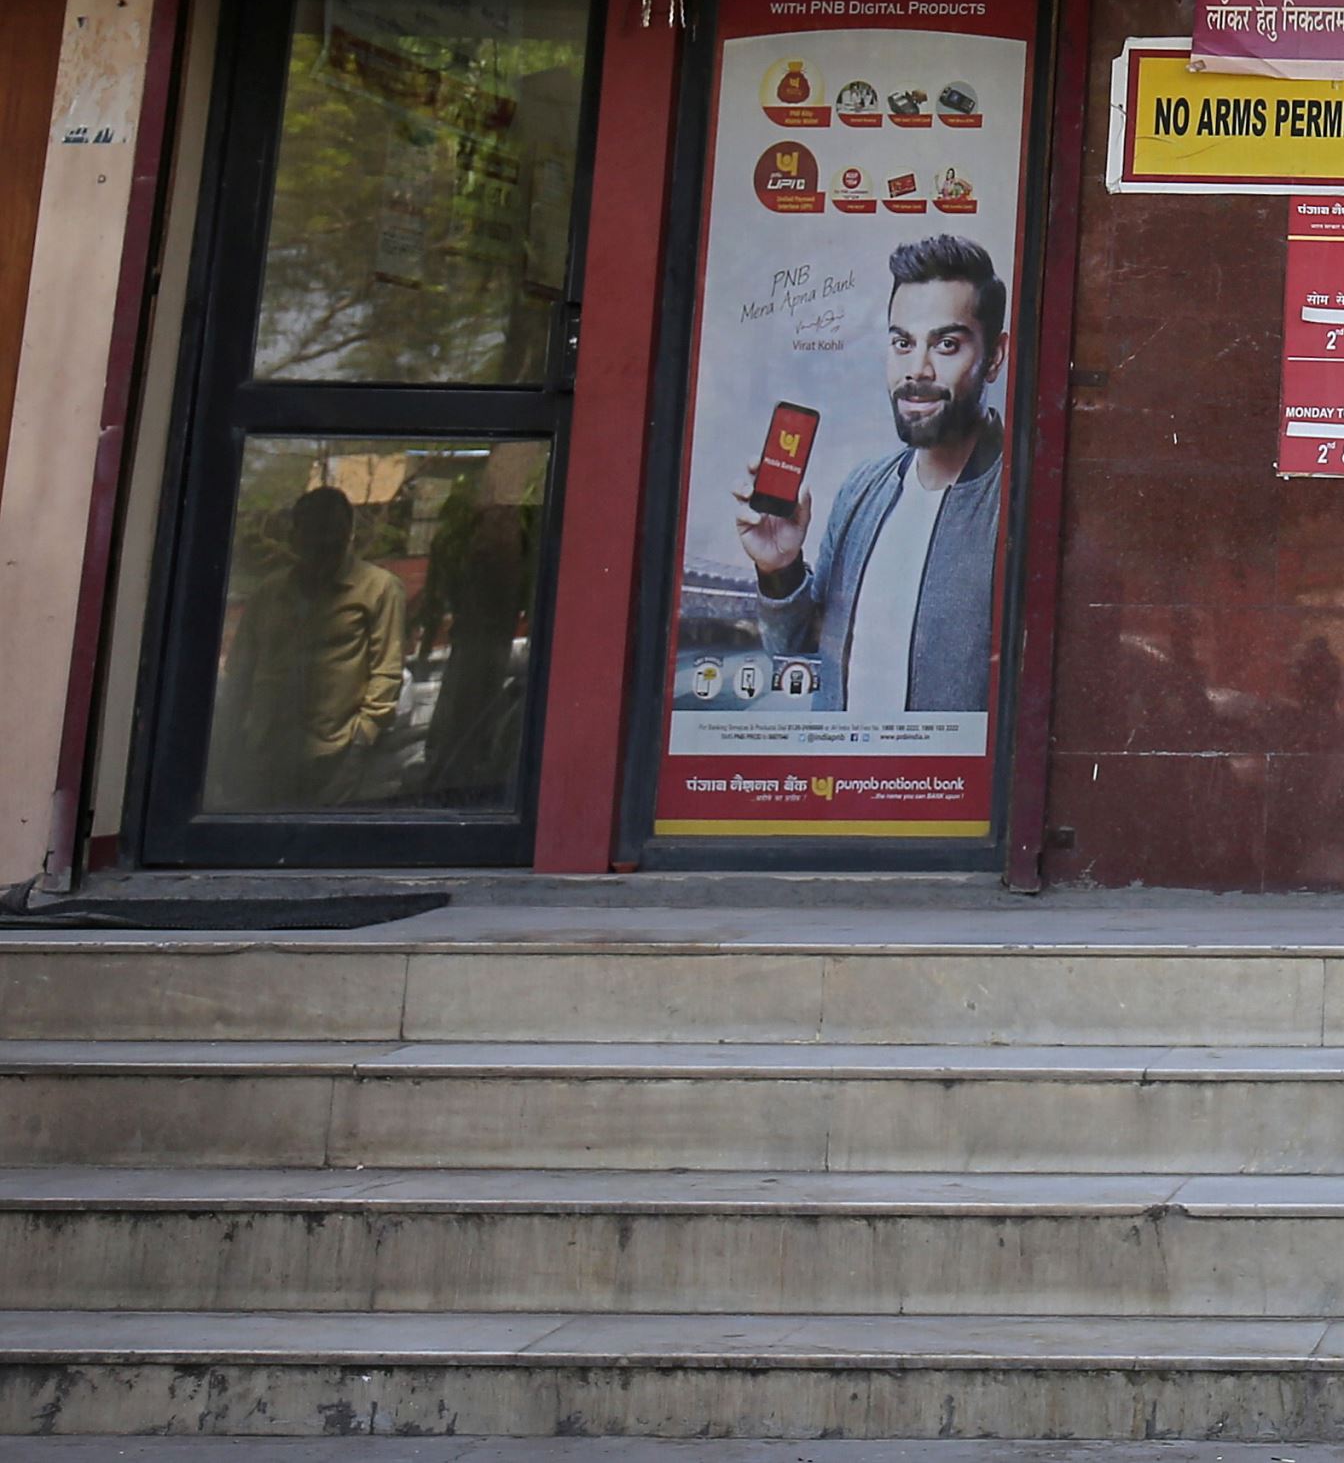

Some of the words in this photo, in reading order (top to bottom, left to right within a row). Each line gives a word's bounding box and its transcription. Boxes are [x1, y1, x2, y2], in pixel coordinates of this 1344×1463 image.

[810, 1, 845, 15] PNB
[1154, 98, 1190, 135] NO
[1197, 98, 1267, 136] ARMS
[771, 265, 810, 297] PNB
[1307, 292, 1328, 305] सोम
[793, 341, 816, 351] Virat
[1286, 407, 1333, 418] MONDAY
[836, 776, 879, 794] punjab
[880, 777, 931, 791] national
[933, 777, 964, 791] bank
